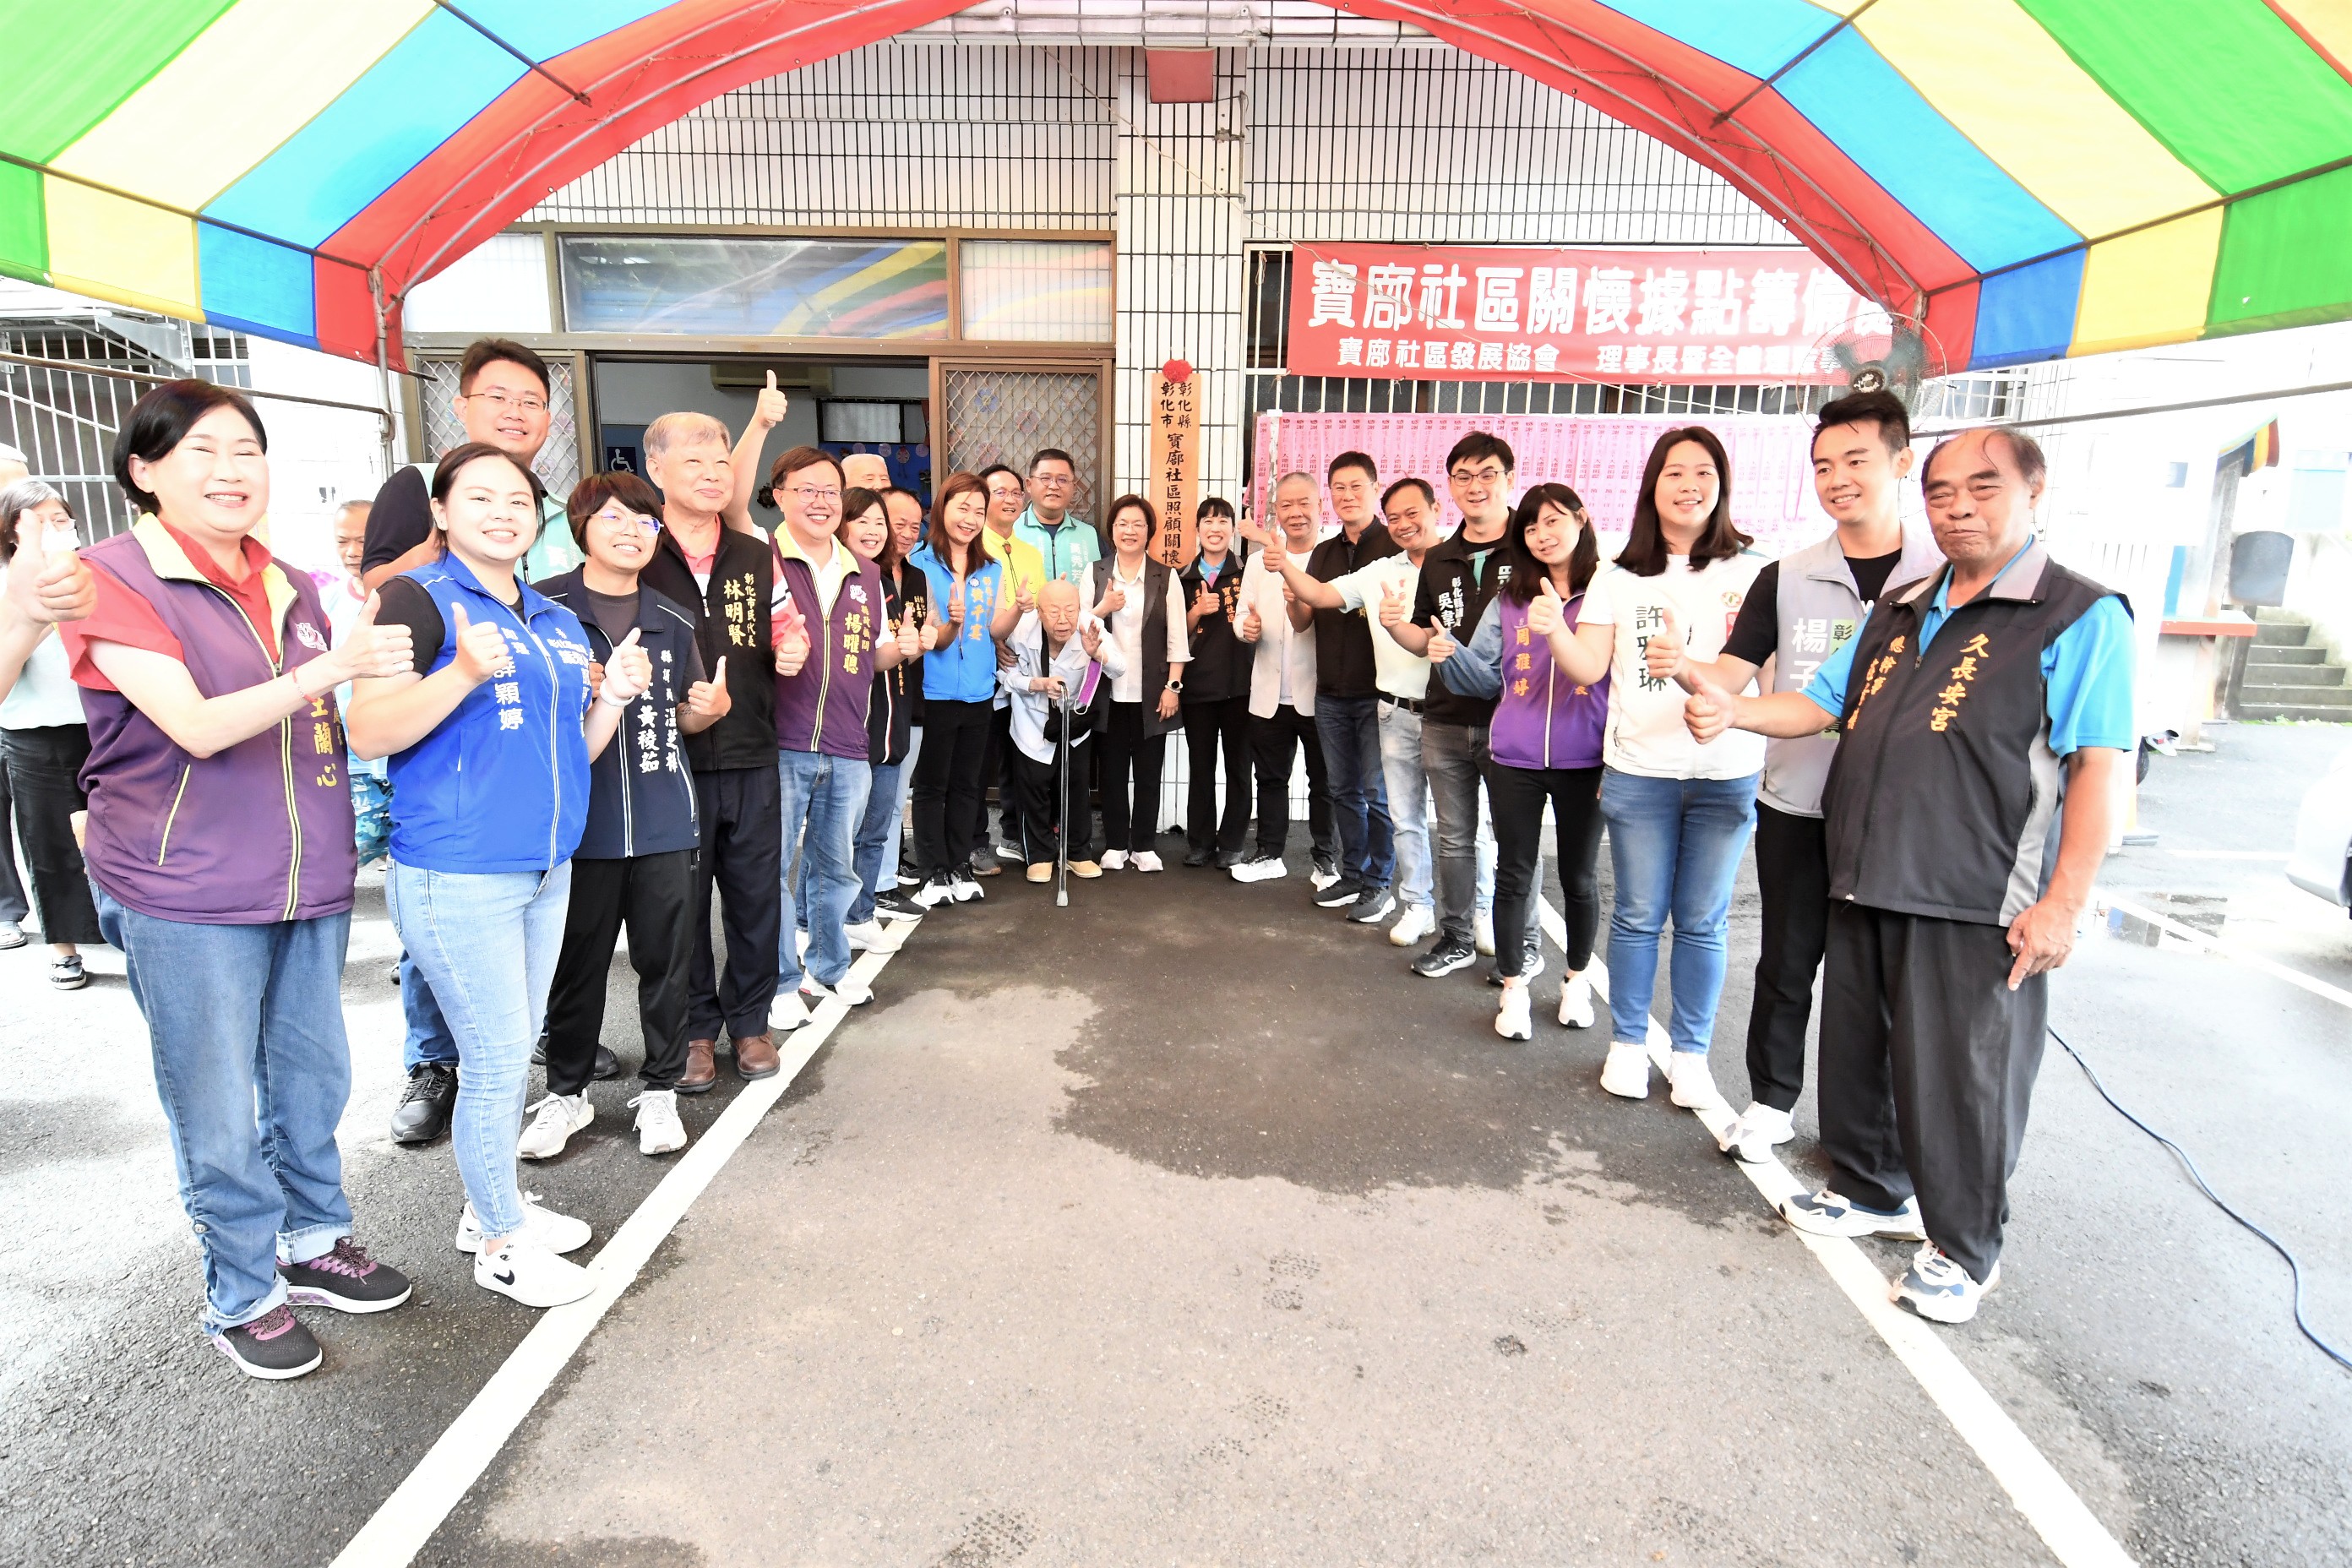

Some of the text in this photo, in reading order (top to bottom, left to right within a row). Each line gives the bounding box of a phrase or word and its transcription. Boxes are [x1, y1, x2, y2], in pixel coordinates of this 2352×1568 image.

[1337, 336, 1560, 372] 寶廍社區發展協會
[1161, 381, 1175, 428] 彰化市
[1178, 381, 1192, 428] 彰化縣
[1162, 433, 1184, 568] 寶廍社區照顧關懷
[723, 579, 746, 646] 林明賢
[1438, 591, 1456, 632] 吳韋
[843, 612, 863, 675] 楊曜聰
[1930, 633, 1990, 732] 久長安宮
